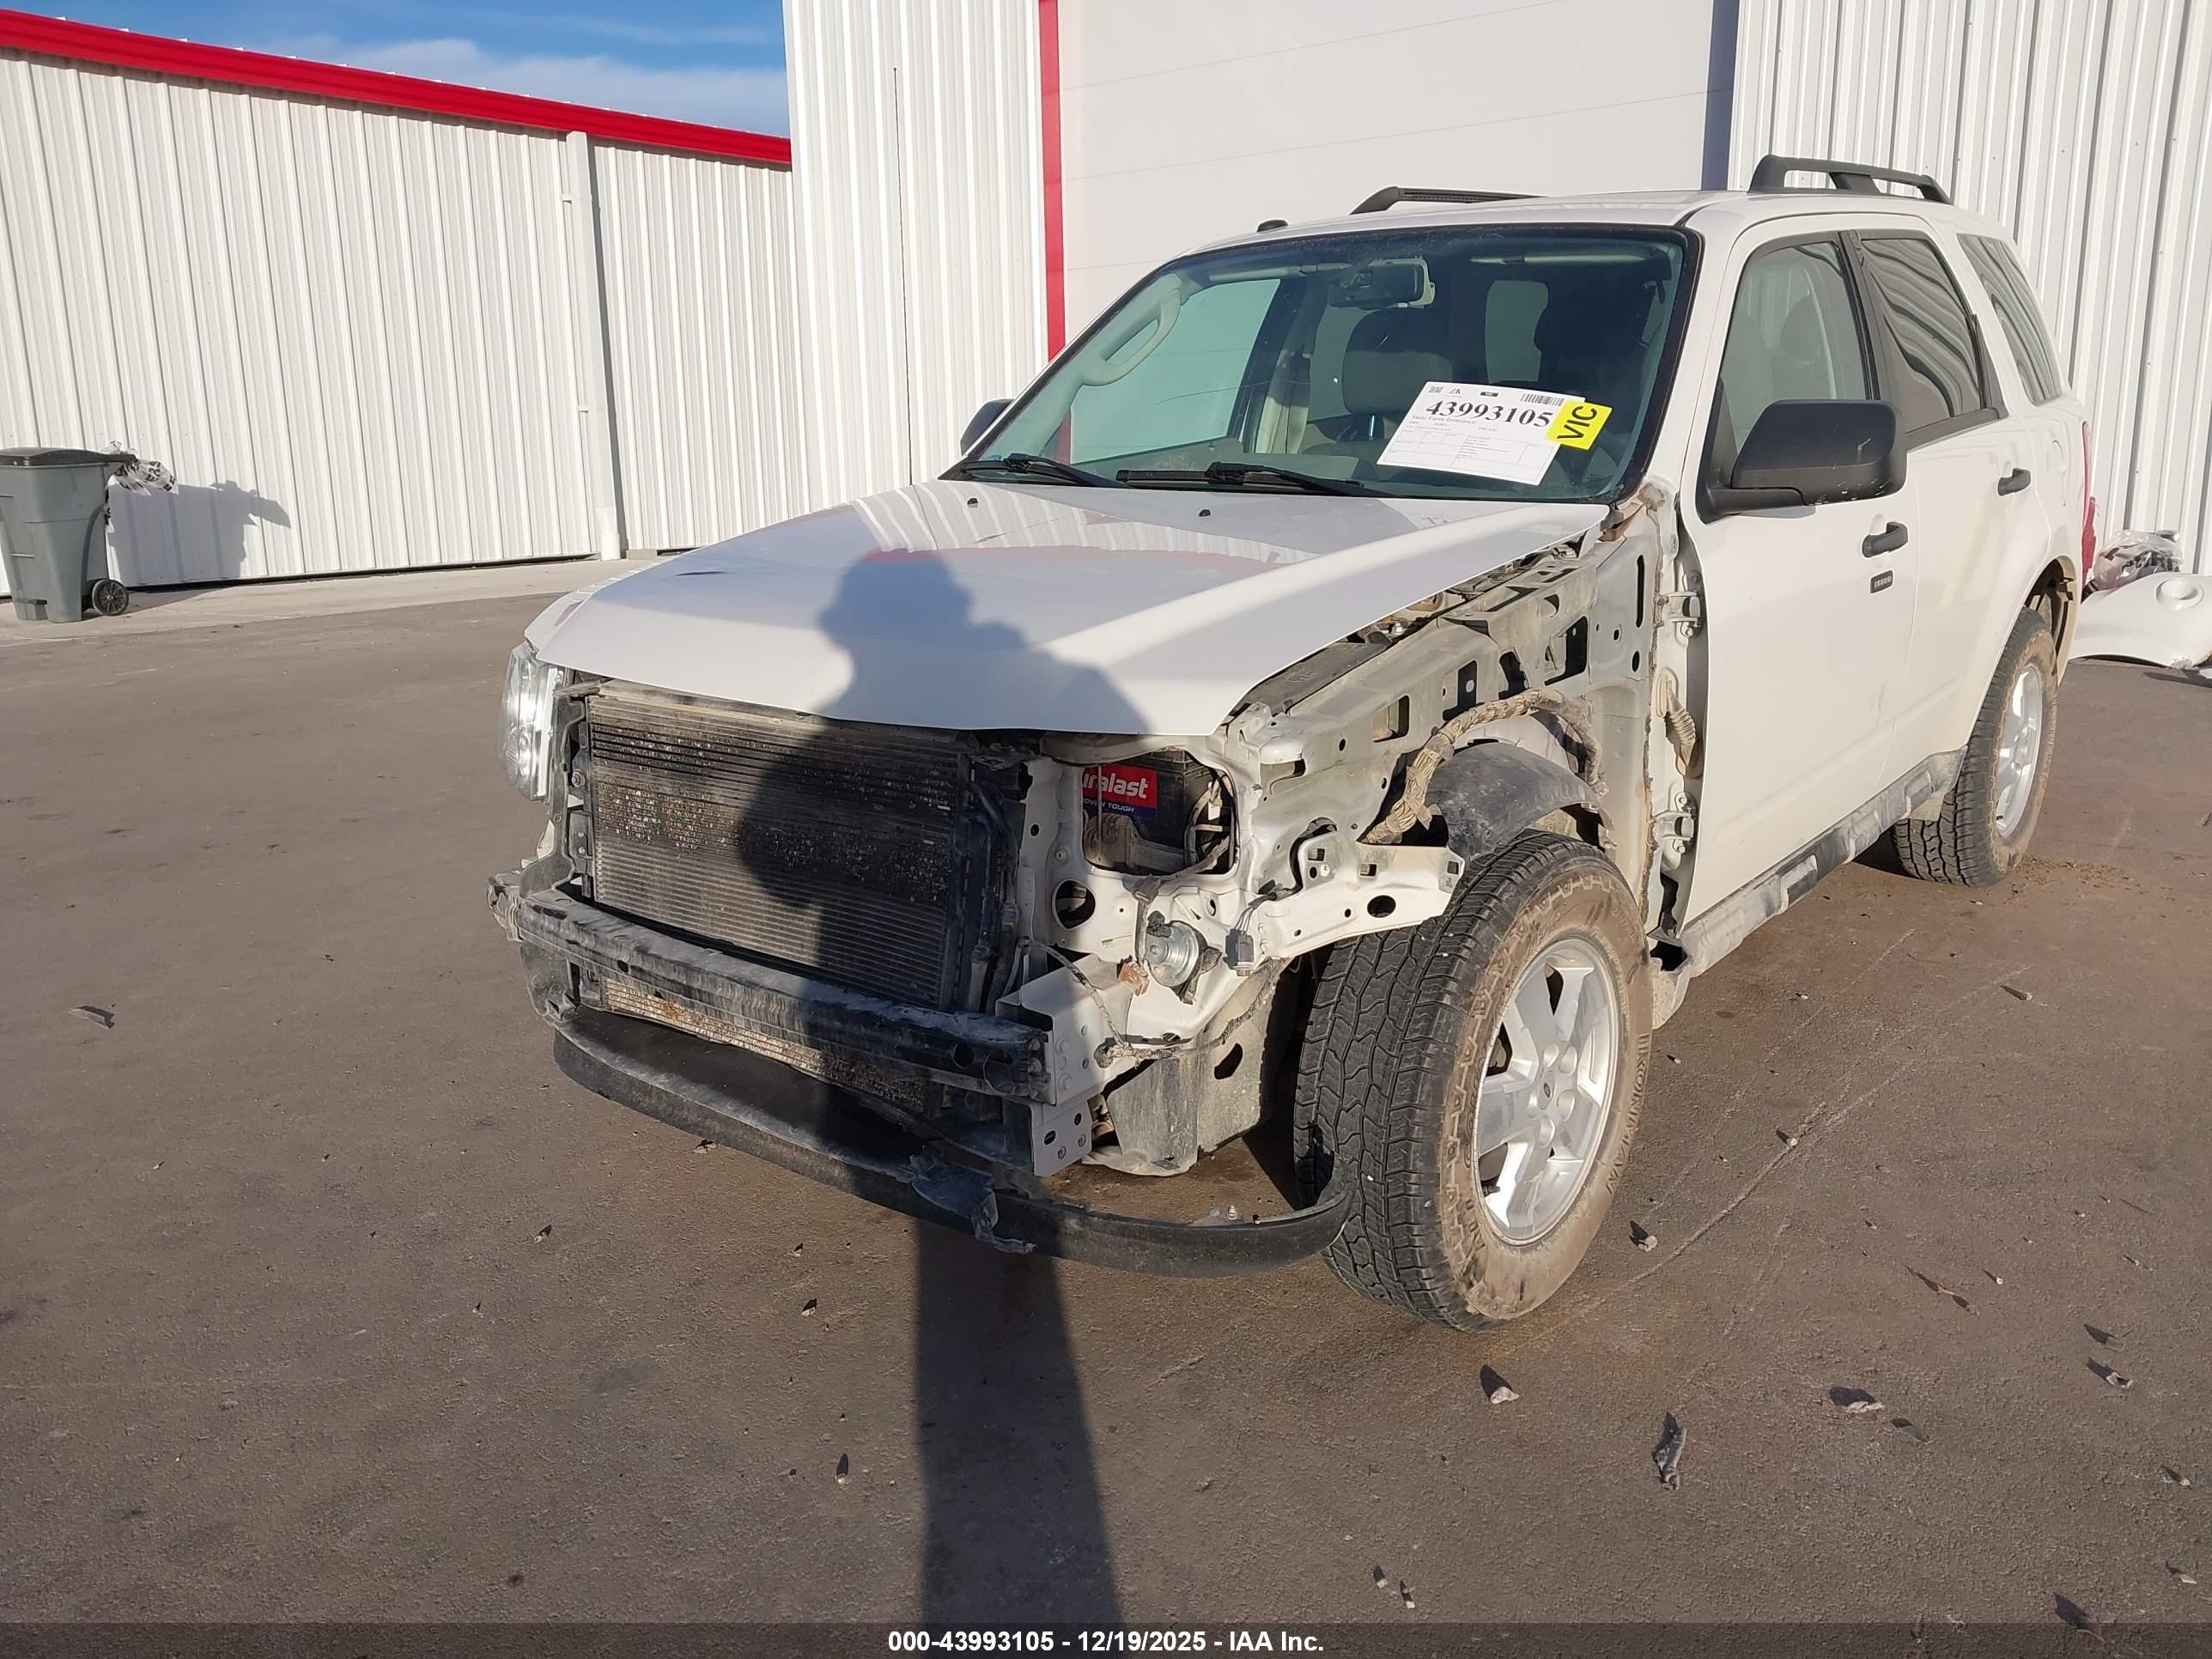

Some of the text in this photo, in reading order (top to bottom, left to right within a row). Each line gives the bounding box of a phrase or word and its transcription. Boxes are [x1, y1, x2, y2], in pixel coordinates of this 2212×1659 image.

[1425, 400, 1553, 428] 43993105
[1557, 405, 1598, 440] VIC
[1107, 802, 1134, 813] TOUGH
